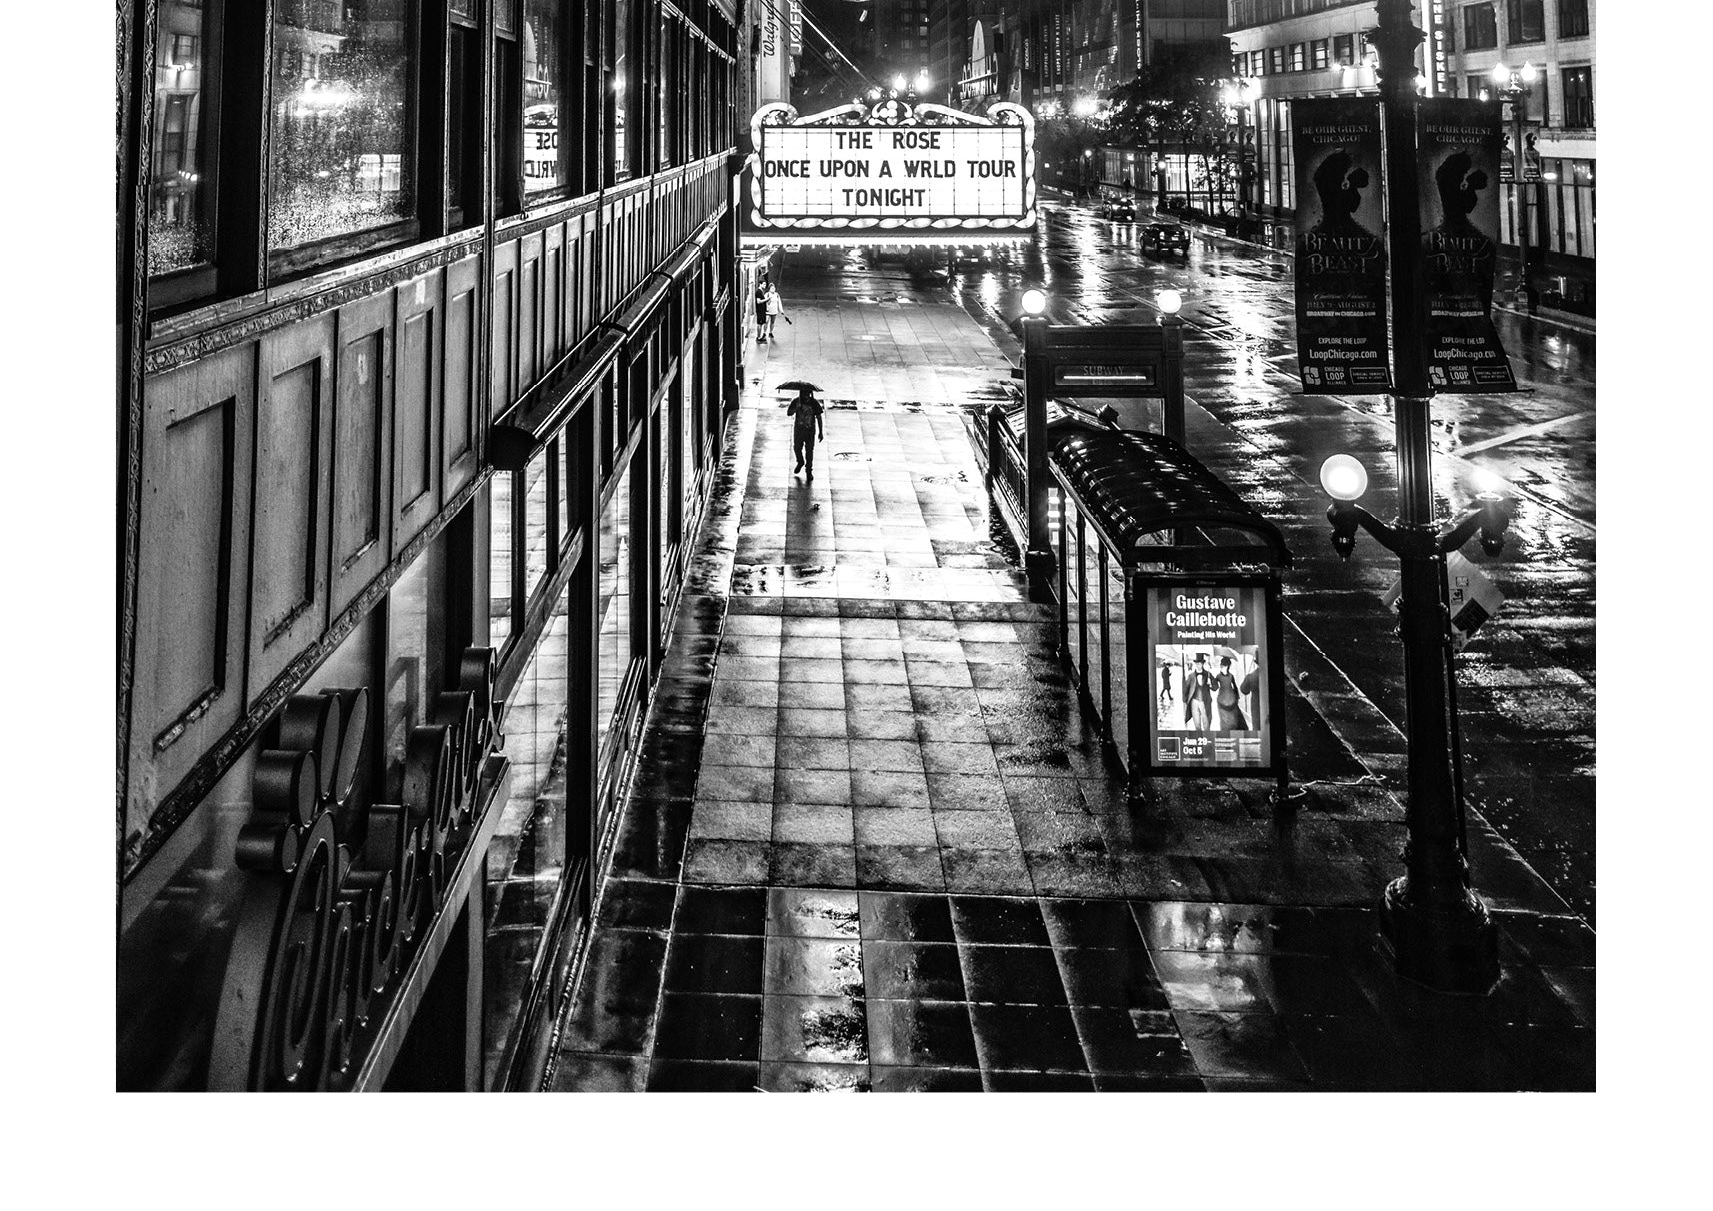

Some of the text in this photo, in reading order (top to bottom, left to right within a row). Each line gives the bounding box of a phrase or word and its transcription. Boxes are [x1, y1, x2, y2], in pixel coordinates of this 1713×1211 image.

[1434, 30, 1446, 93] SISKEL
[1302, 126, 1314, 134] BE
[1315, 126, 1336, 134] OUR
[1426, 125, 1438, 133] BE
[1439, 125, 1459, 134] OUR
[836, 131, 941, 150] THE ROSE
[765, 160, 1016, 178] ONCE UPON A WRLD TOUR
[842, 188, 926, 207] TONIGHT
[1318, 337, 1367, 345] EXPLORE THE LOOP
[1309, 348, 1378, 361] LoopChicago.com
[1083, 365, 1125, 375] SUBWAY
[1325, 372, 1345, 381] LOOP
[1450, 372, 1469, 380] LOOP
[1176, 594, 1236, 609] Gustave
[1166, 612, 1247, 627] Caillebotte
[1177, 631, 1205, 640] Painting
[1183, 737, 1197, 746] Jun
[1183, 746, 1203, 755] Oct 5
